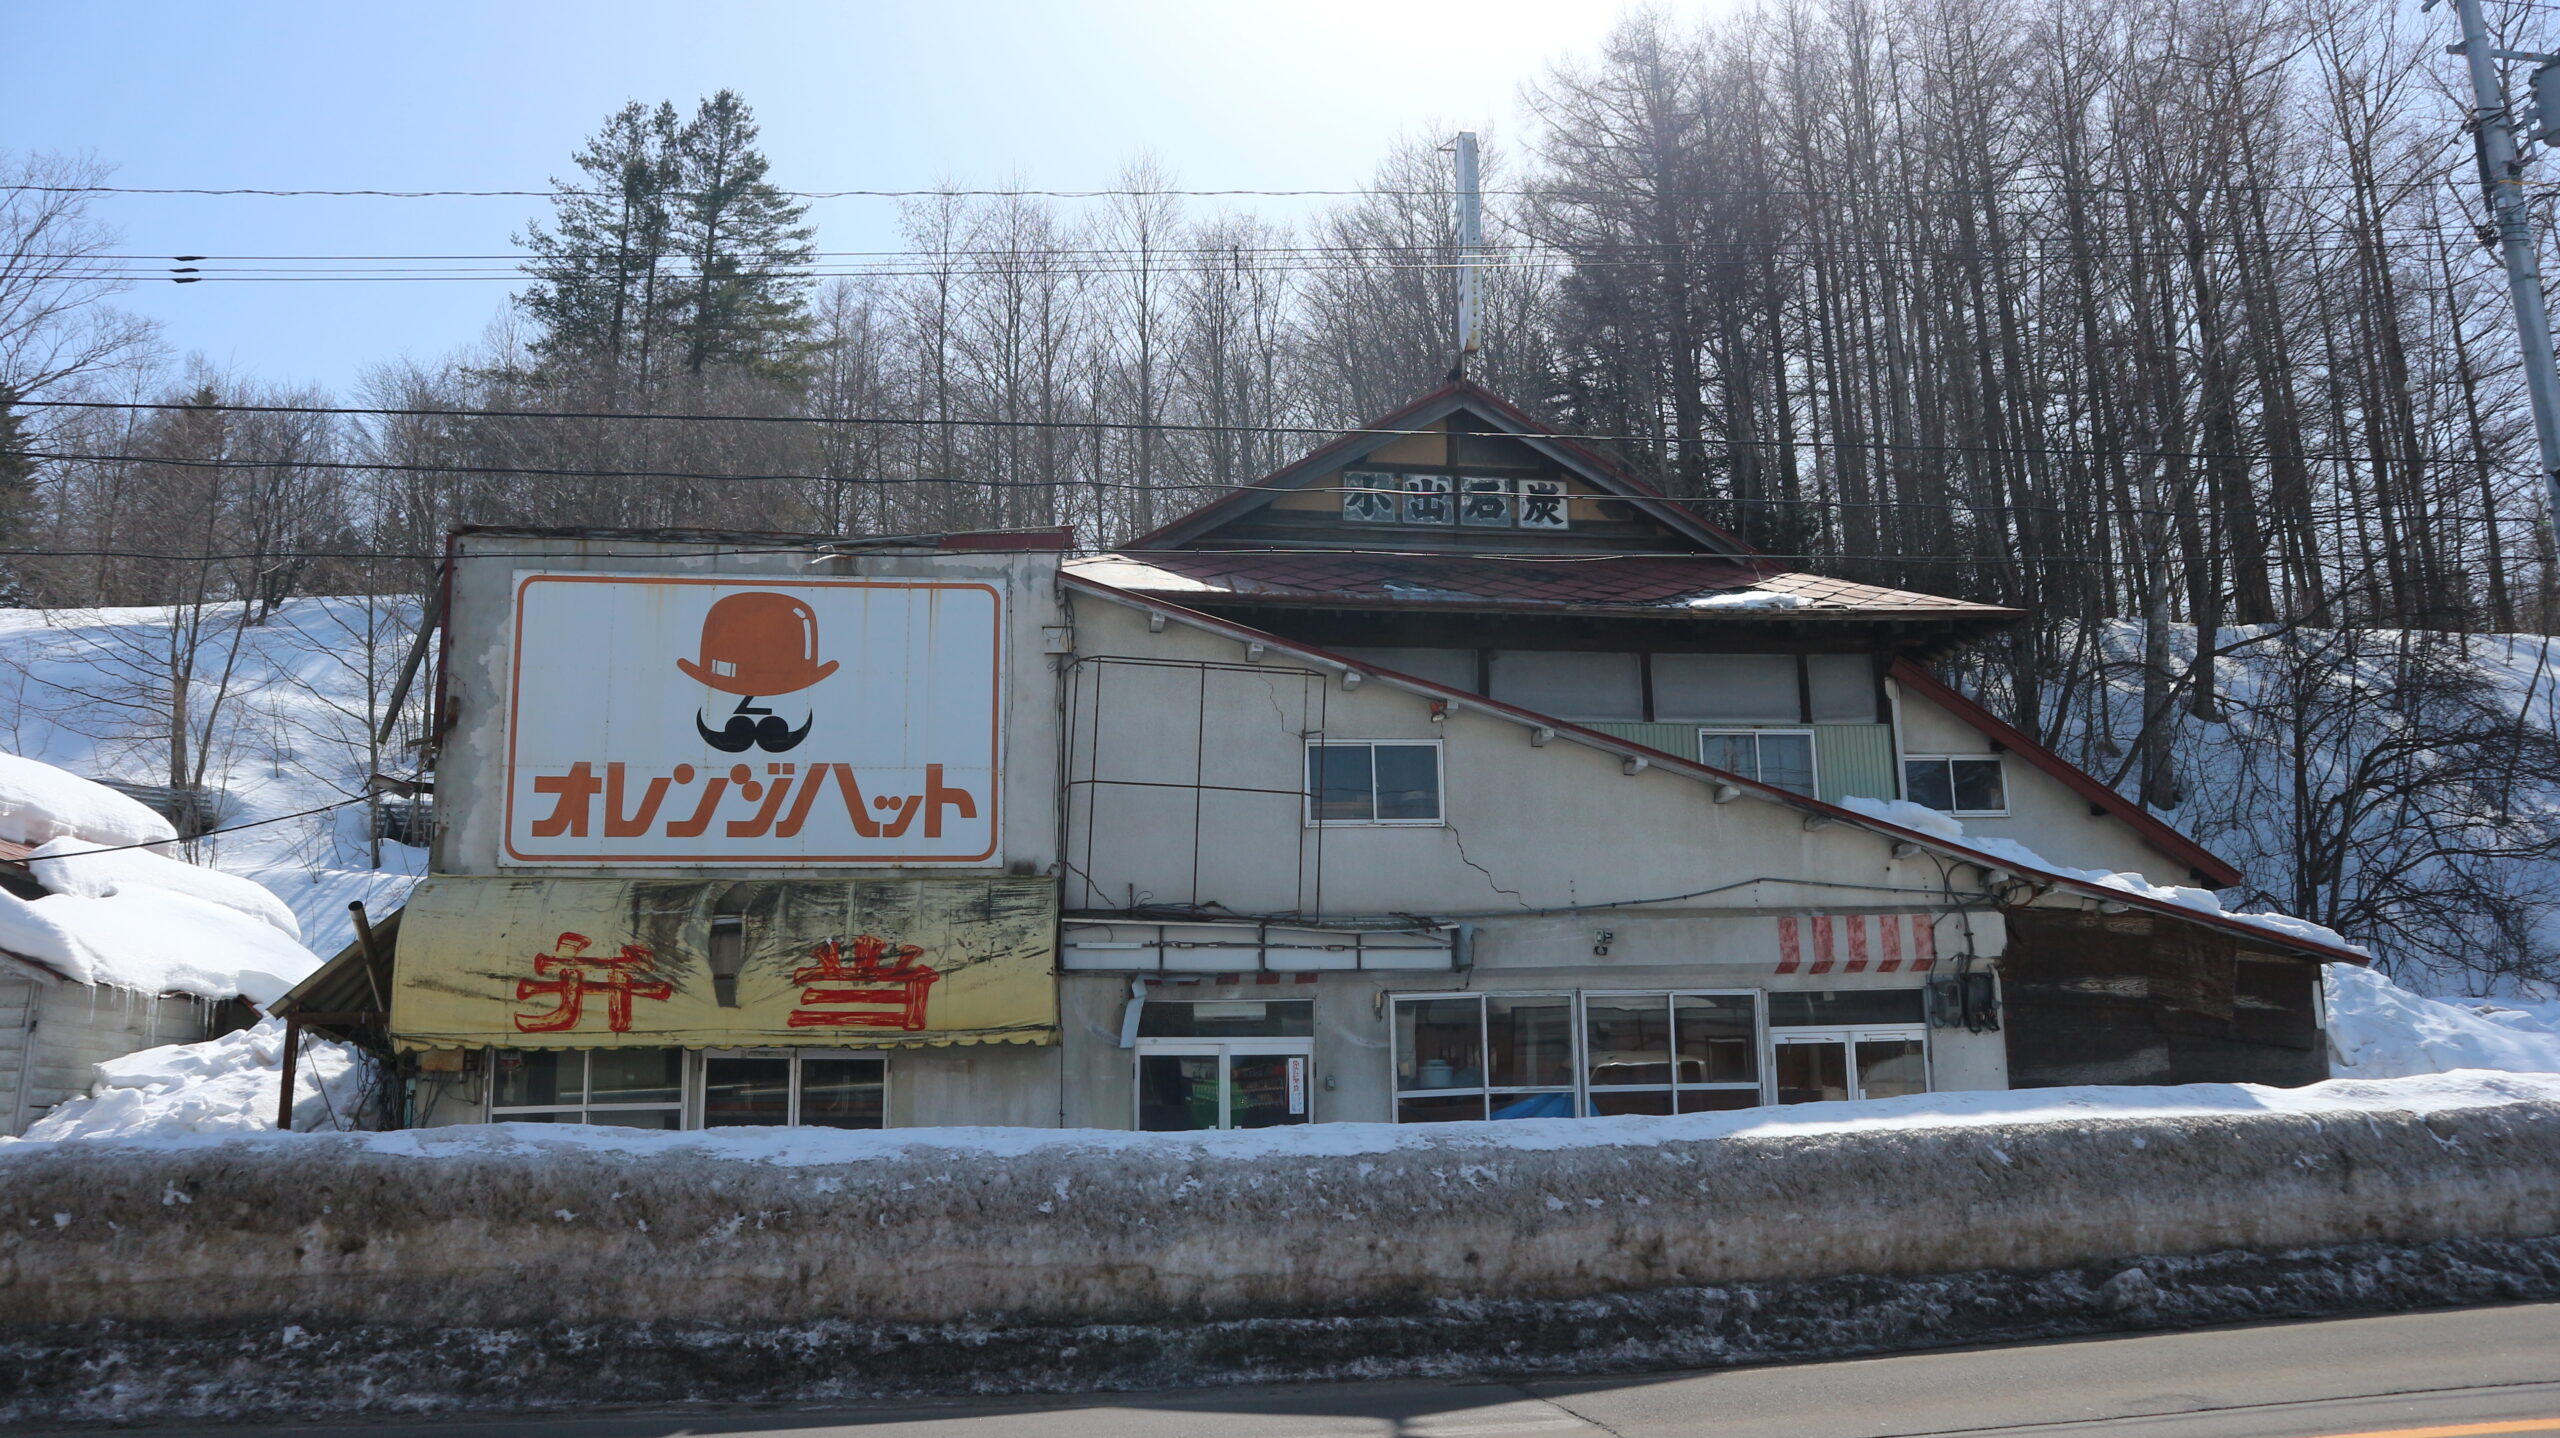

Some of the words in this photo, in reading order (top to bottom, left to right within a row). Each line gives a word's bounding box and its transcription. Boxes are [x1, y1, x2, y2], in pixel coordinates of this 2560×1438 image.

[530, 761, 978, 839] オレンジハット
[513, 931, 940, 1033] 弁当
